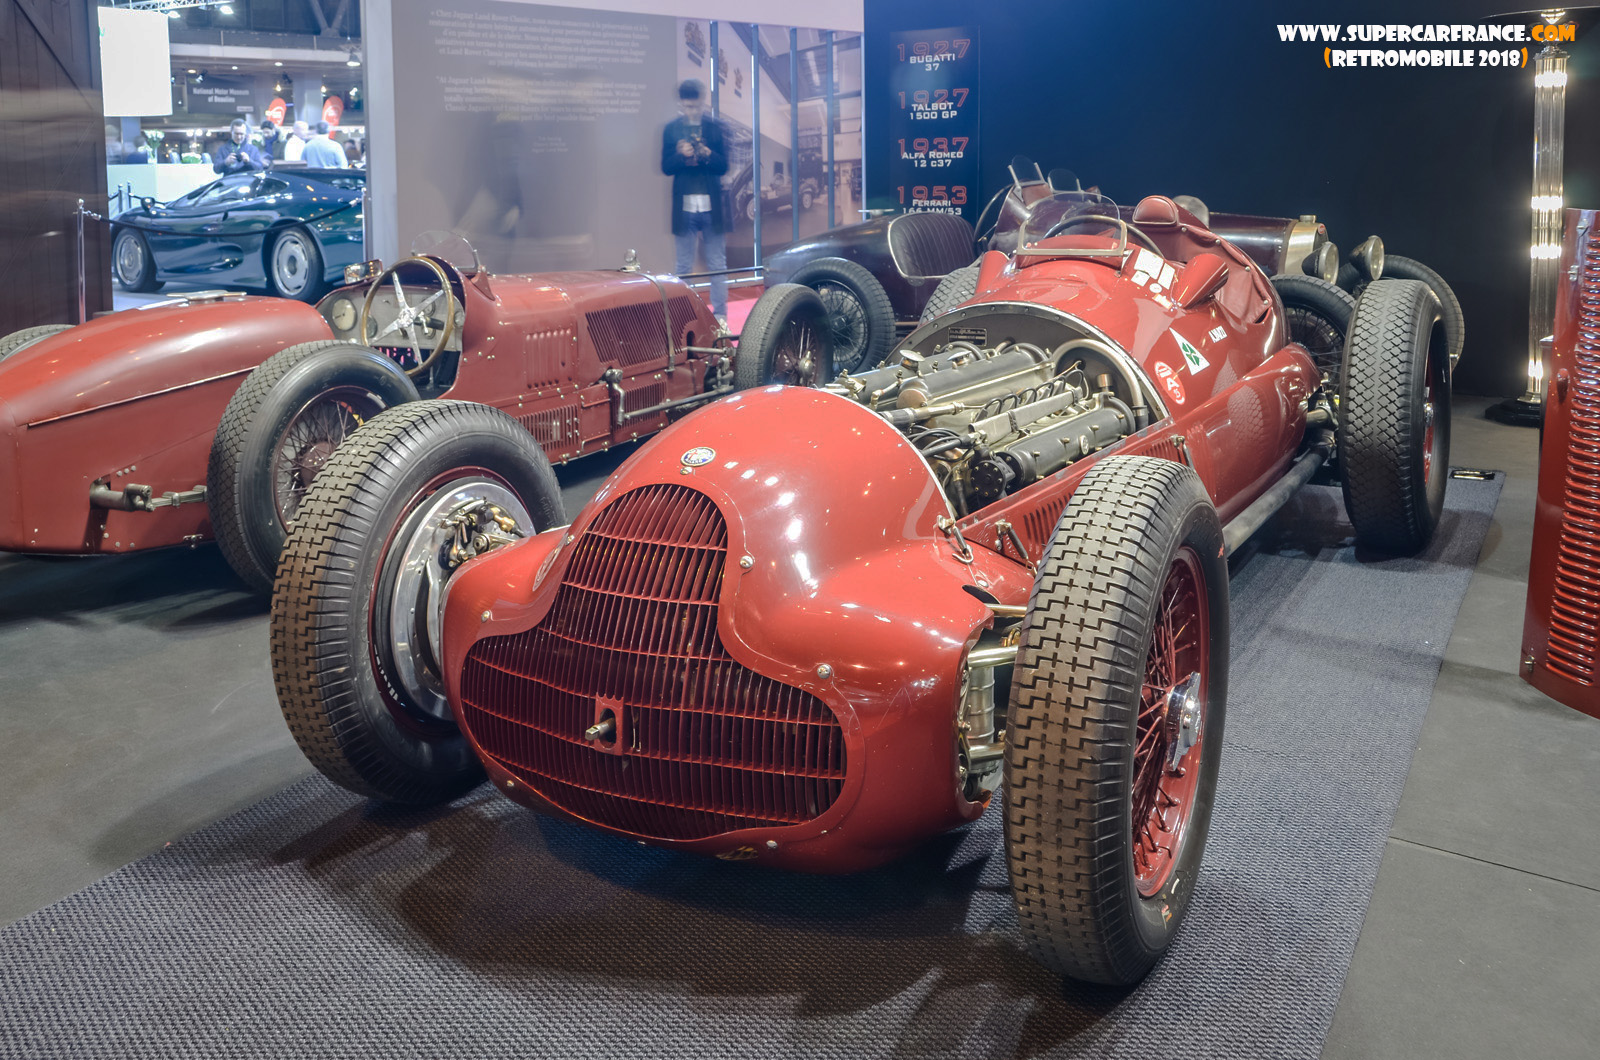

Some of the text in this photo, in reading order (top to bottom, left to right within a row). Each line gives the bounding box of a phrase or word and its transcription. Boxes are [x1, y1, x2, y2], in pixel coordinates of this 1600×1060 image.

[898, 38, 970, 62] 1927
[910, 54, 956, 64] BUGATTI
[898, 88, 970, 109] 1927
[912, 102, 954, 112] TALBOT
[910, 110, 958, 120] 1500 GP
[898, 137, 969, 157] 1937
[897, 185, 968, 205] 1953
